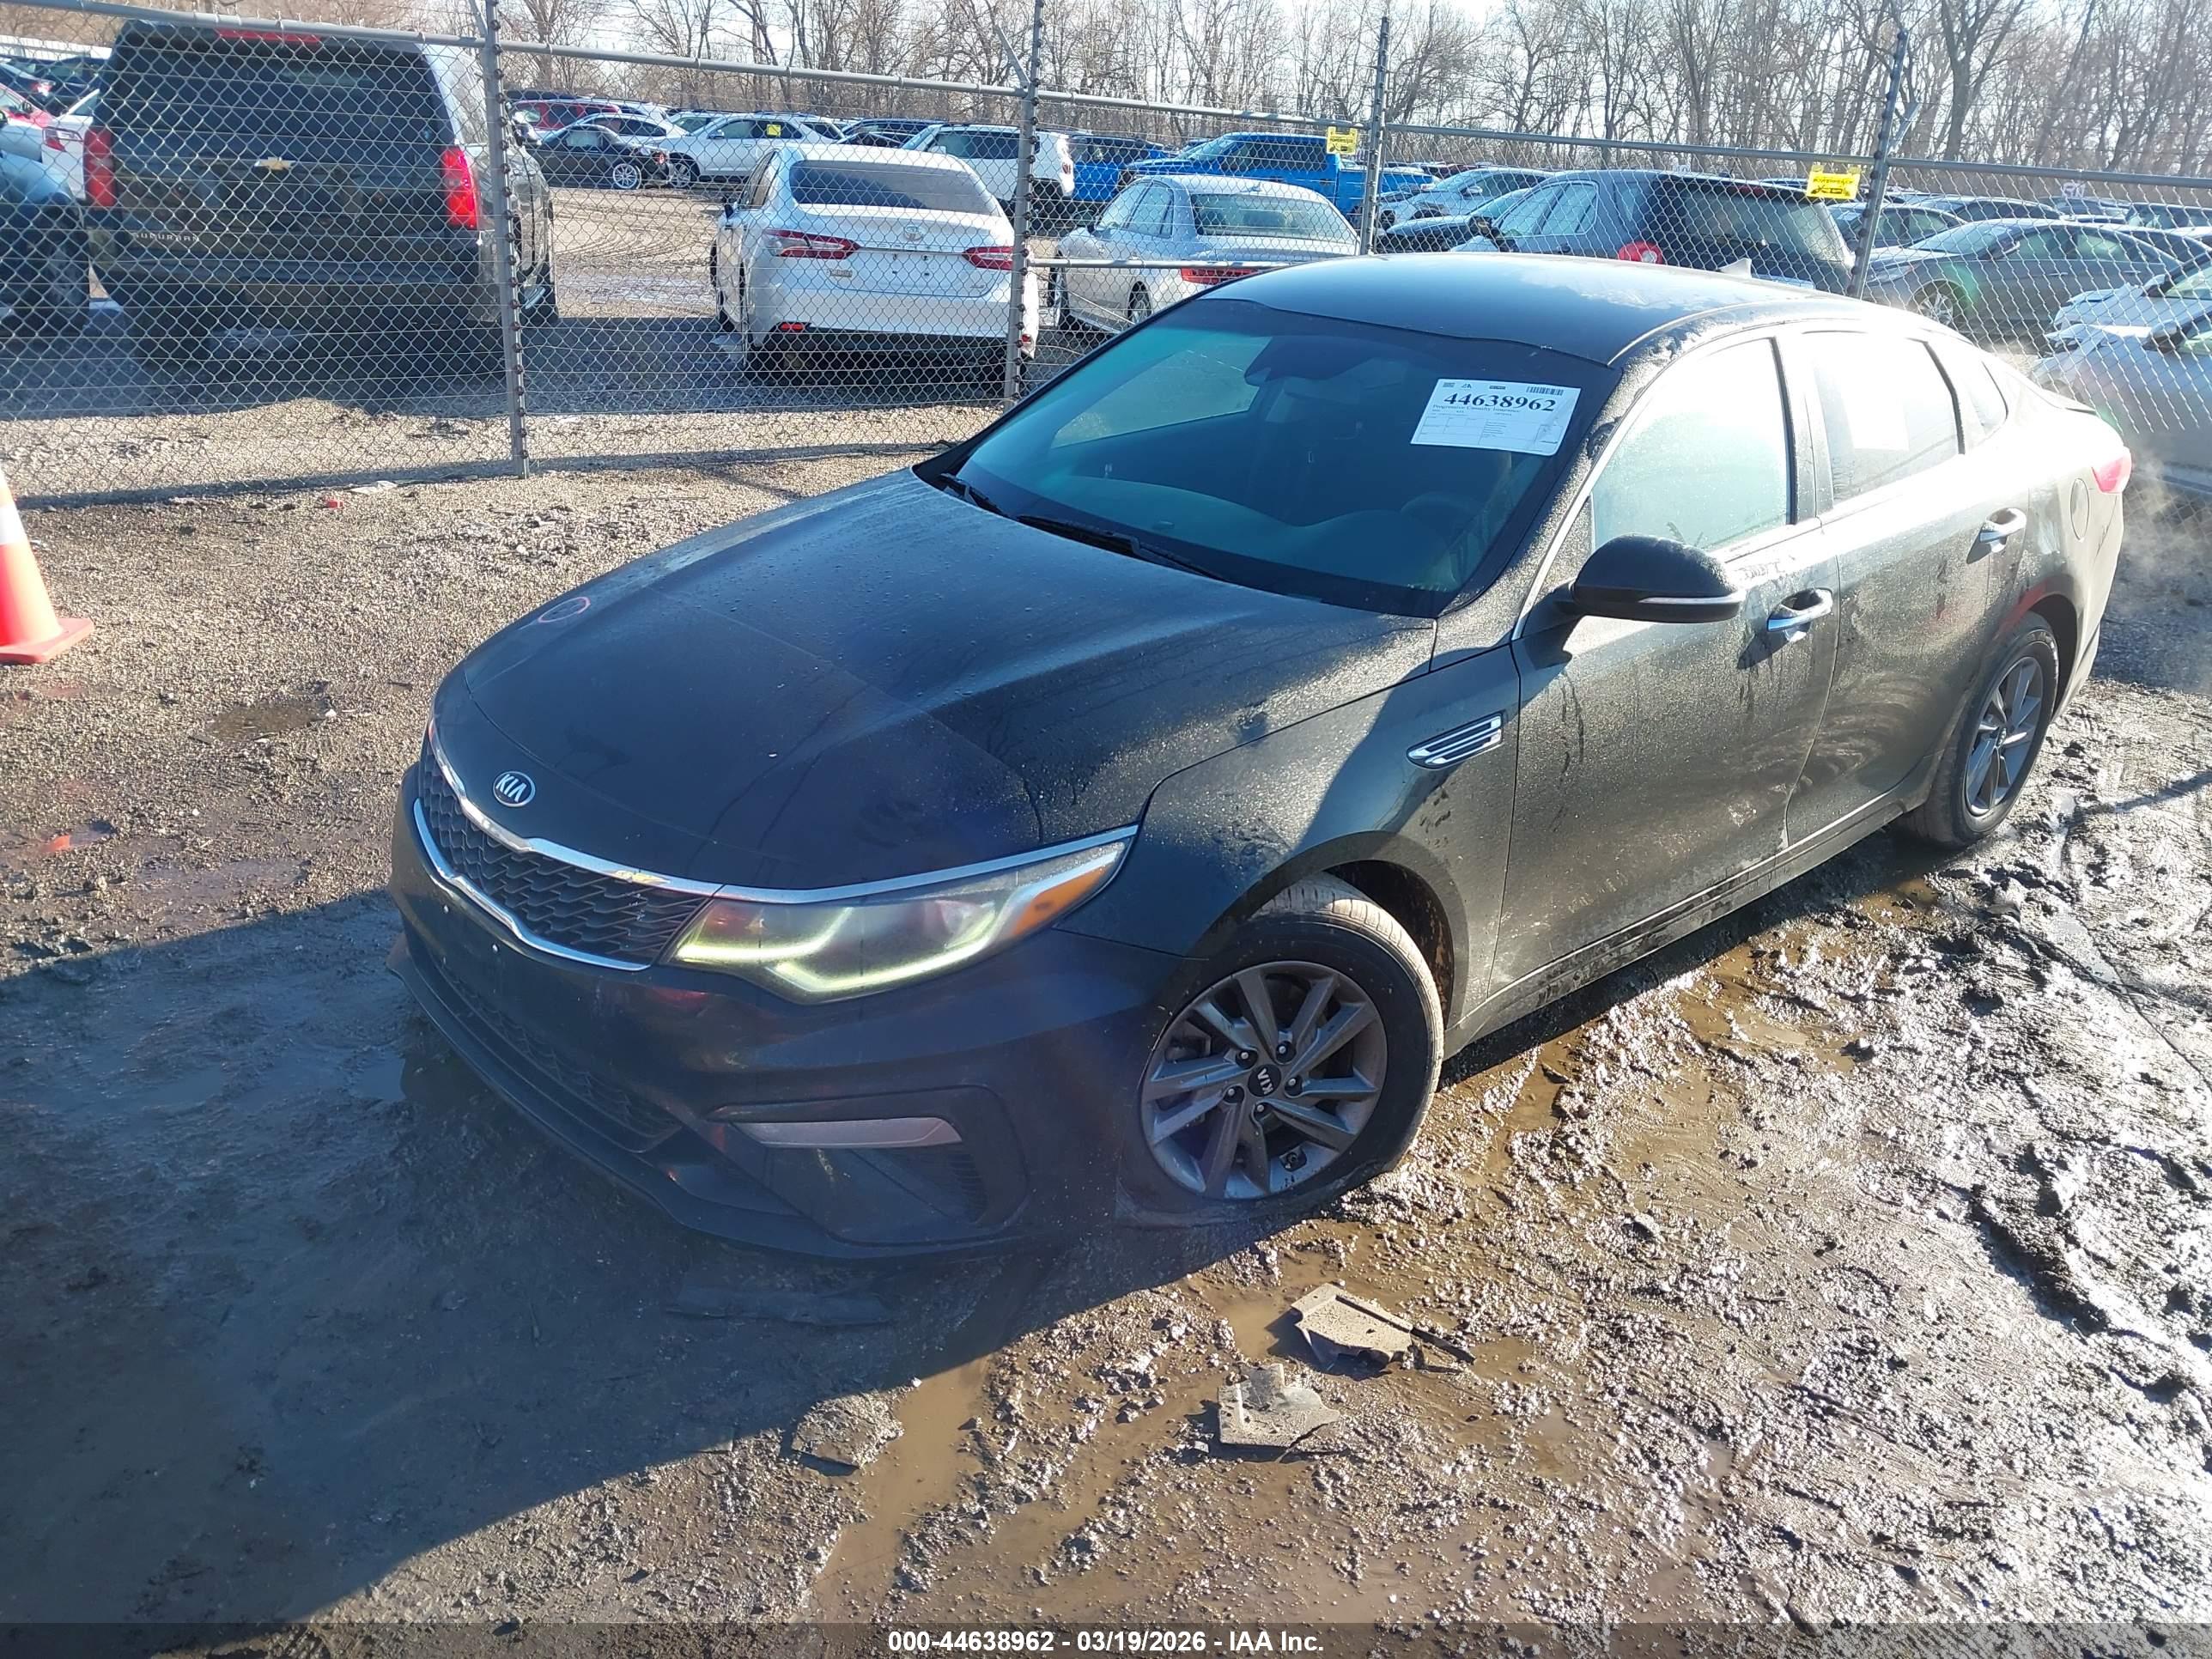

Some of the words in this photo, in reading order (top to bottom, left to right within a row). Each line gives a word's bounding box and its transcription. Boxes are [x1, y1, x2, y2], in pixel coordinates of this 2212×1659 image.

[1443, 392, 1556, 412] 44638962
[495, 773, 527, 803] KIA
[1257, 1067, 1273, 1095] KIA
